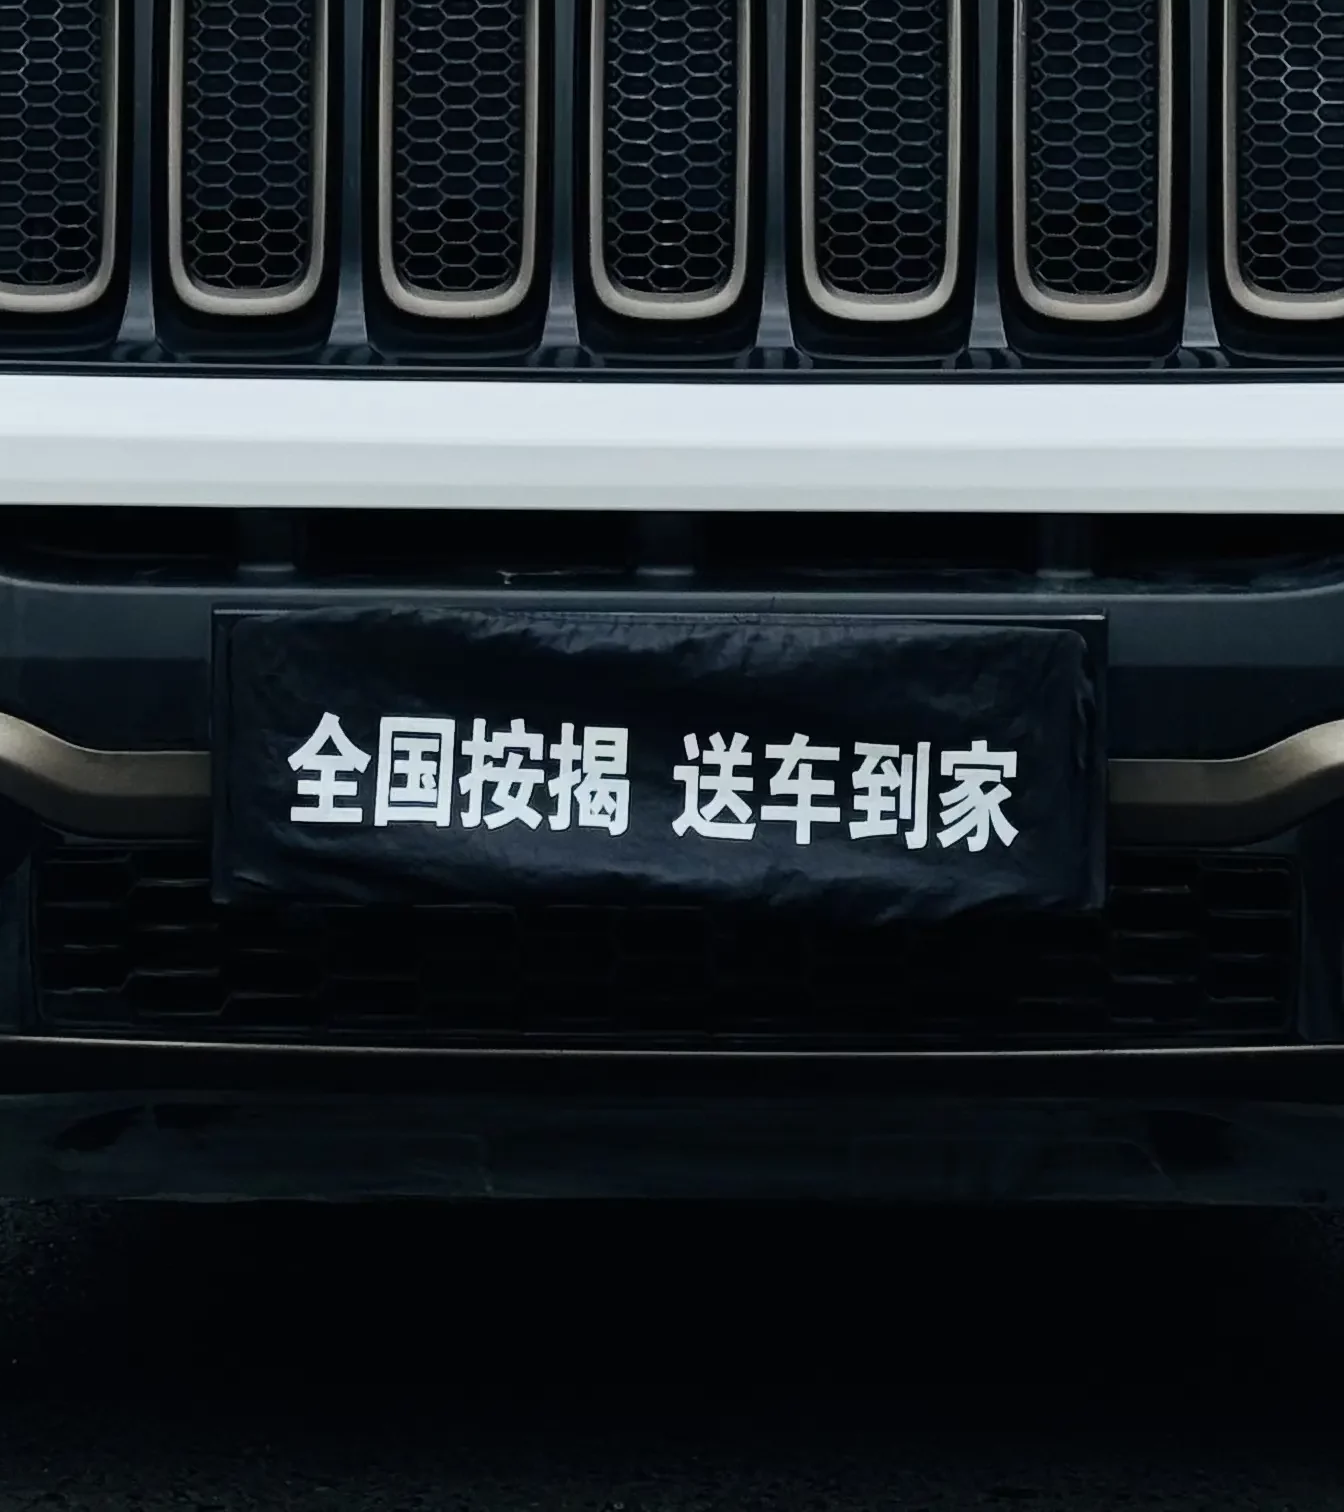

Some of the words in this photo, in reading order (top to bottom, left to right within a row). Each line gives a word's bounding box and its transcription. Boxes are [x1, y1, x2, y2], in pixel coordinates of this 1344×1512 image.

[287, 711, 630, 835] 全国按揭
[671, 731, 1019, 852] 送车到家
